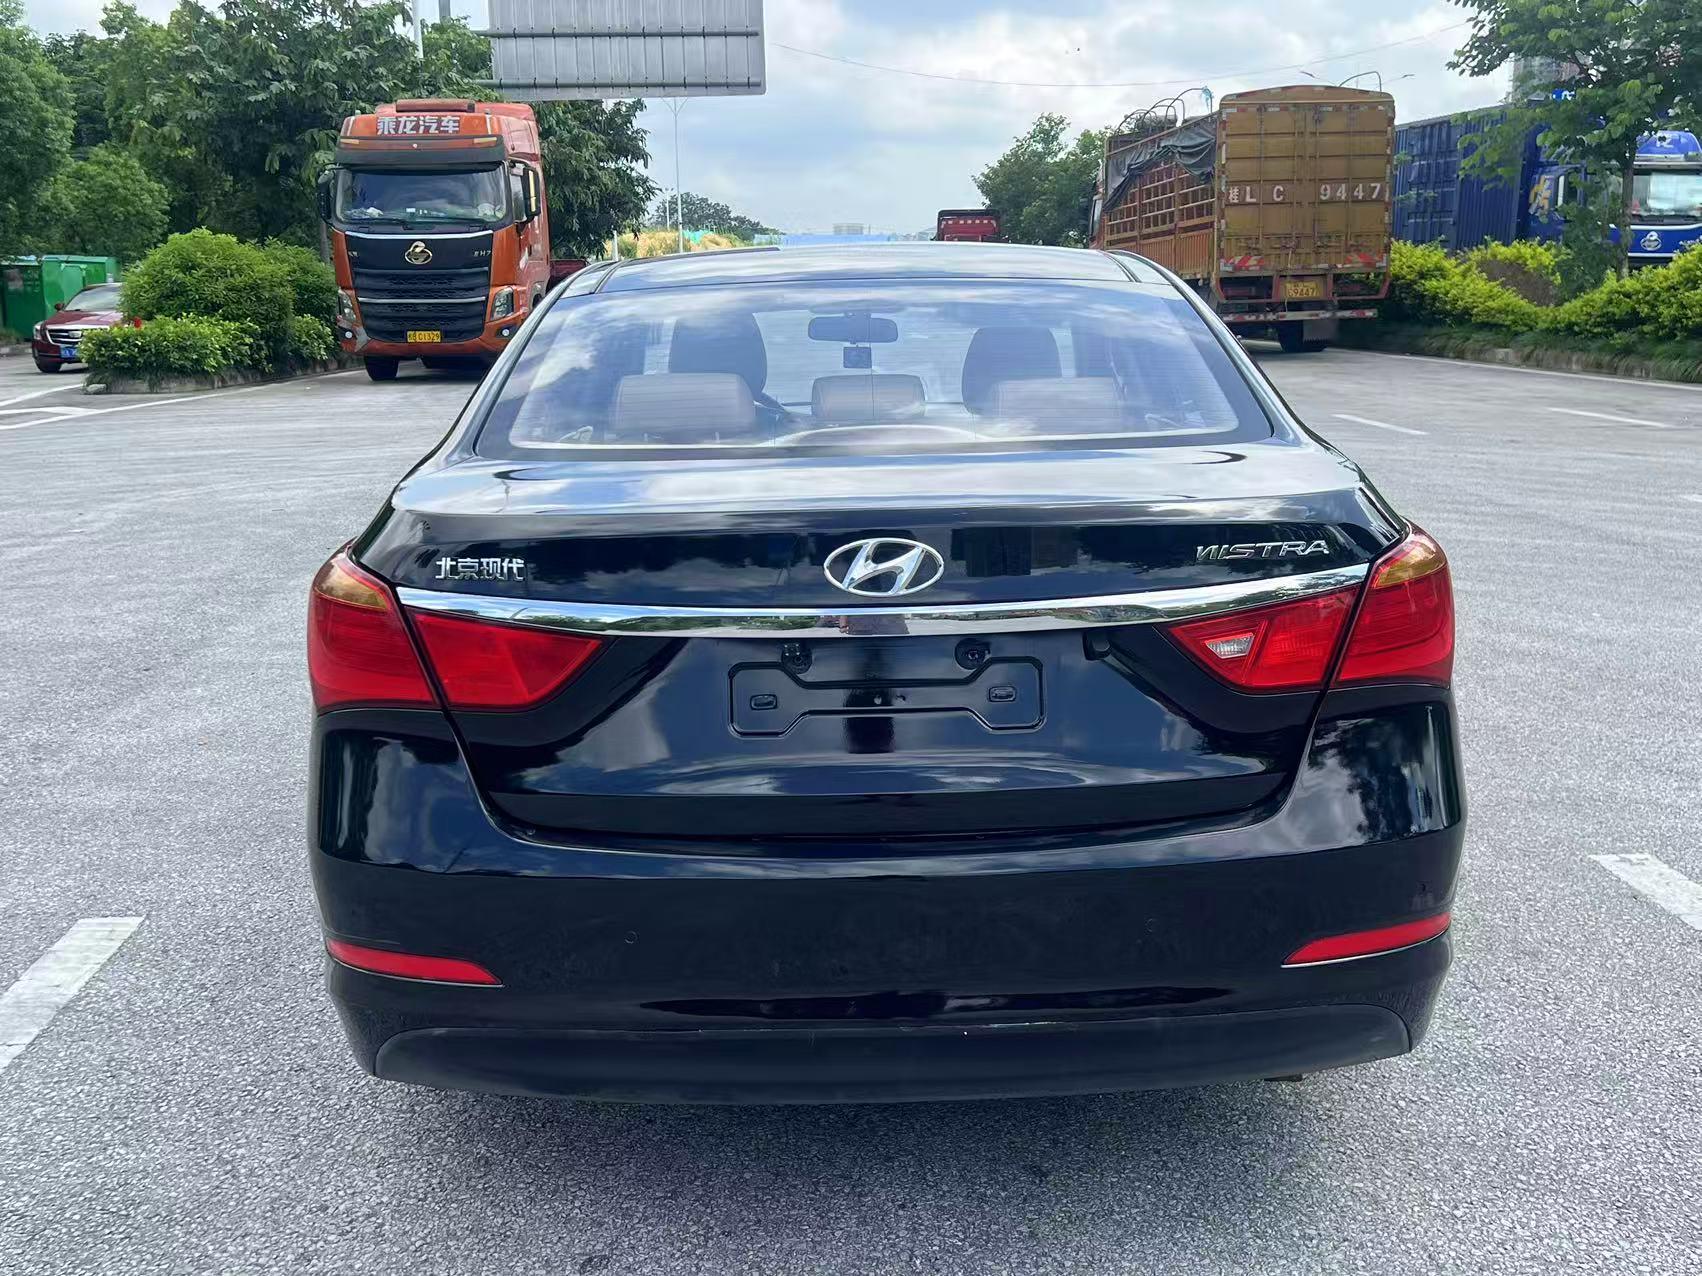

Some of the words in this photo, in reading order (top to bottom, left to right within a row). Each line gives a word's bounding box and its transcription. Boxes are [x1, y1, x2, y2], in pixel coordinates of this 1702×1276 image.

[377, 115, 460, 135] 乘龙汽车
[1320, 183, 1381, 200] 9447
[435, 557, 525, 581] 北京现代
